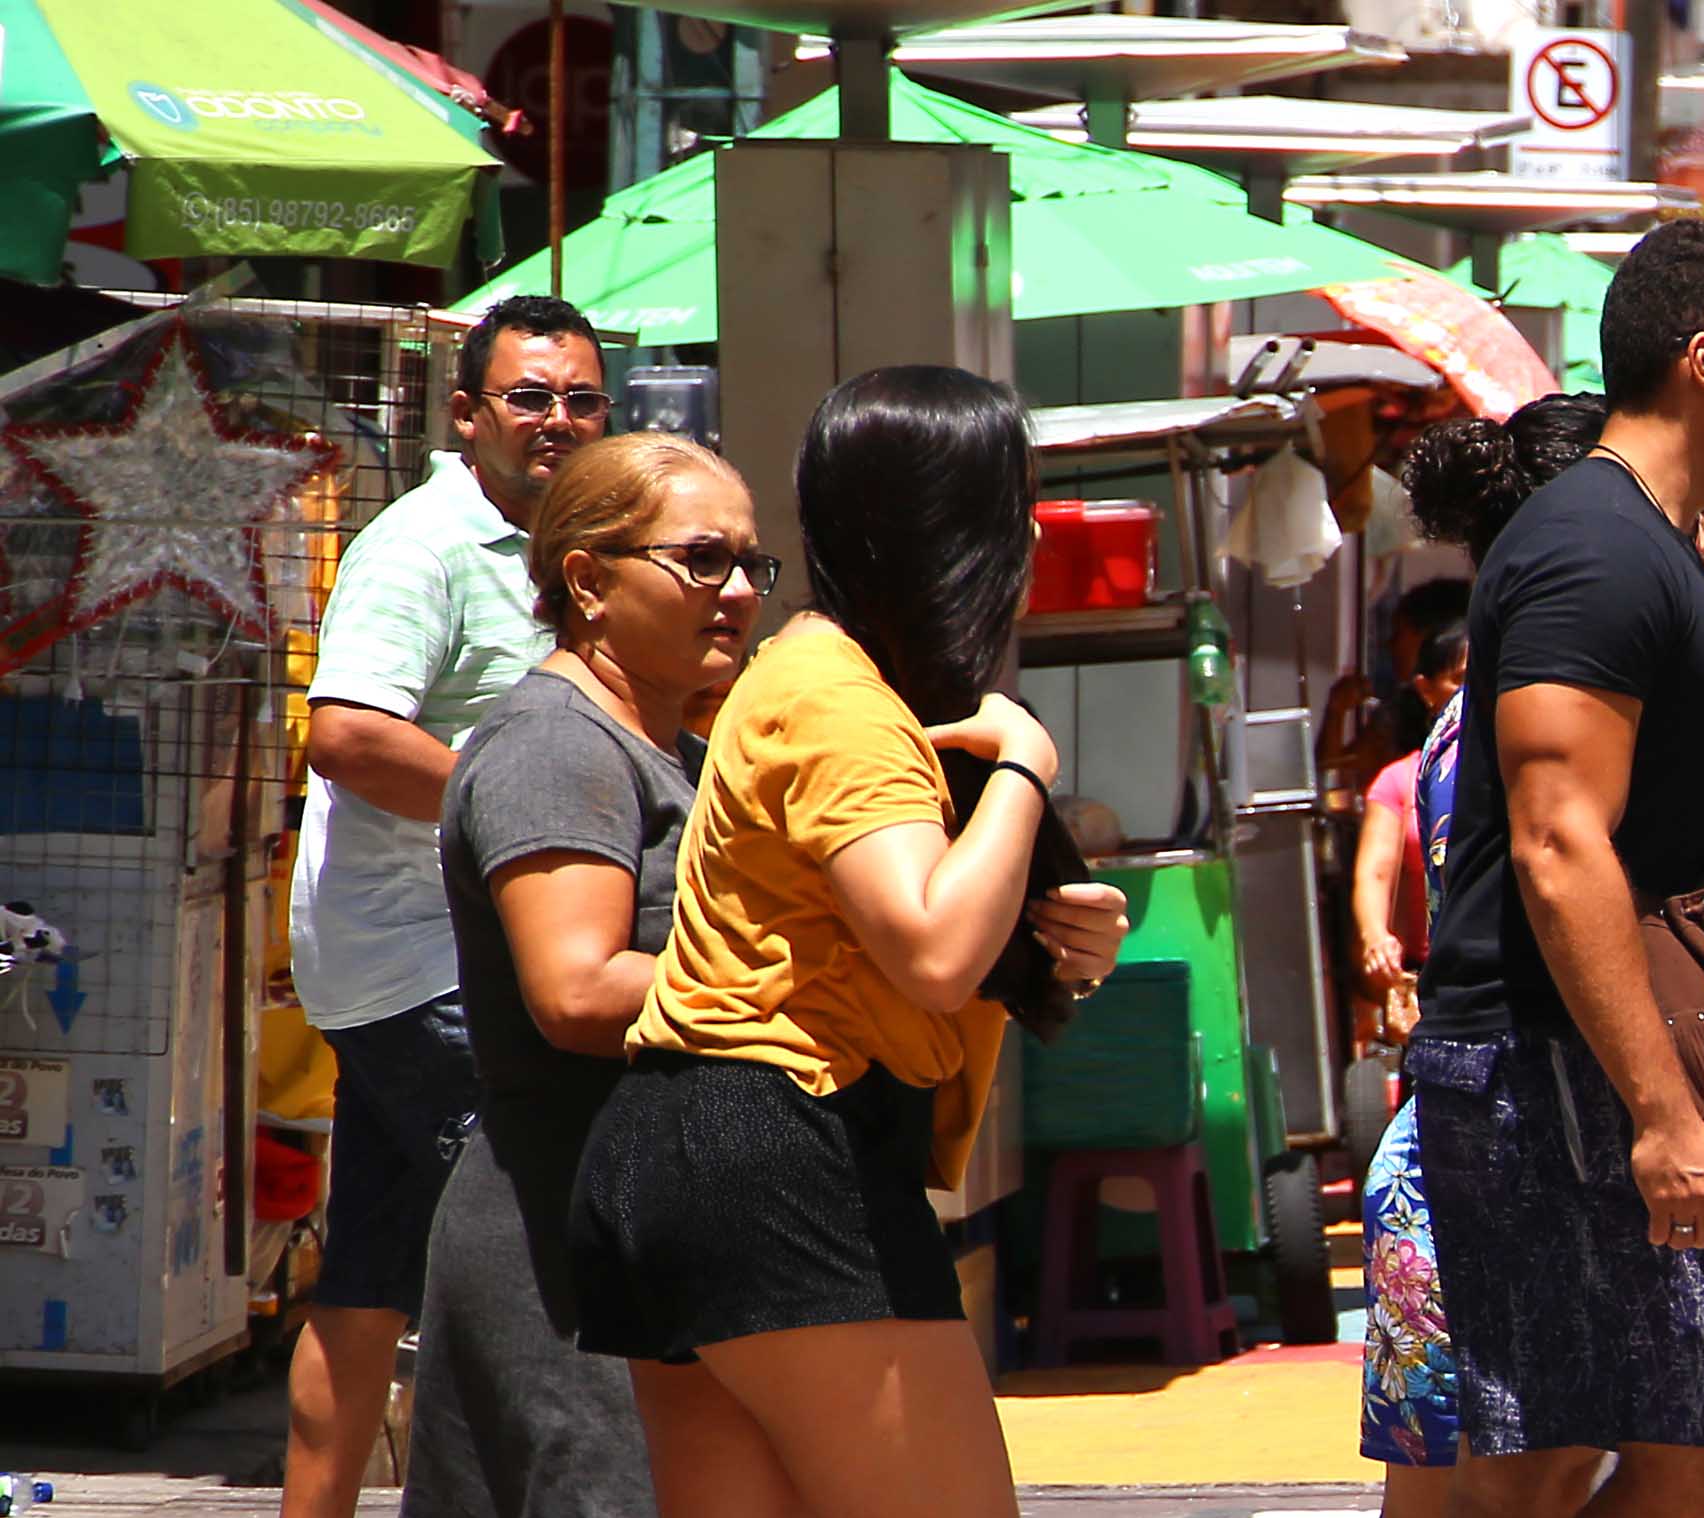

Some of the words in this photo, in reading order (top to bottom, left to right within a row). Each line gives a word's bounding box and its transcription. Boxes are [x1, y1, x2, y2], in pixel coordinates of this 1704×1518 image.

[1557, 61, 1588, 107] E
[190, 96, 365, 120] ODONTO
[0, 1077, 17, 1105] 2
[48, 1168, 79, 1180] Povo
[0, 1221, 41, 1243] das
